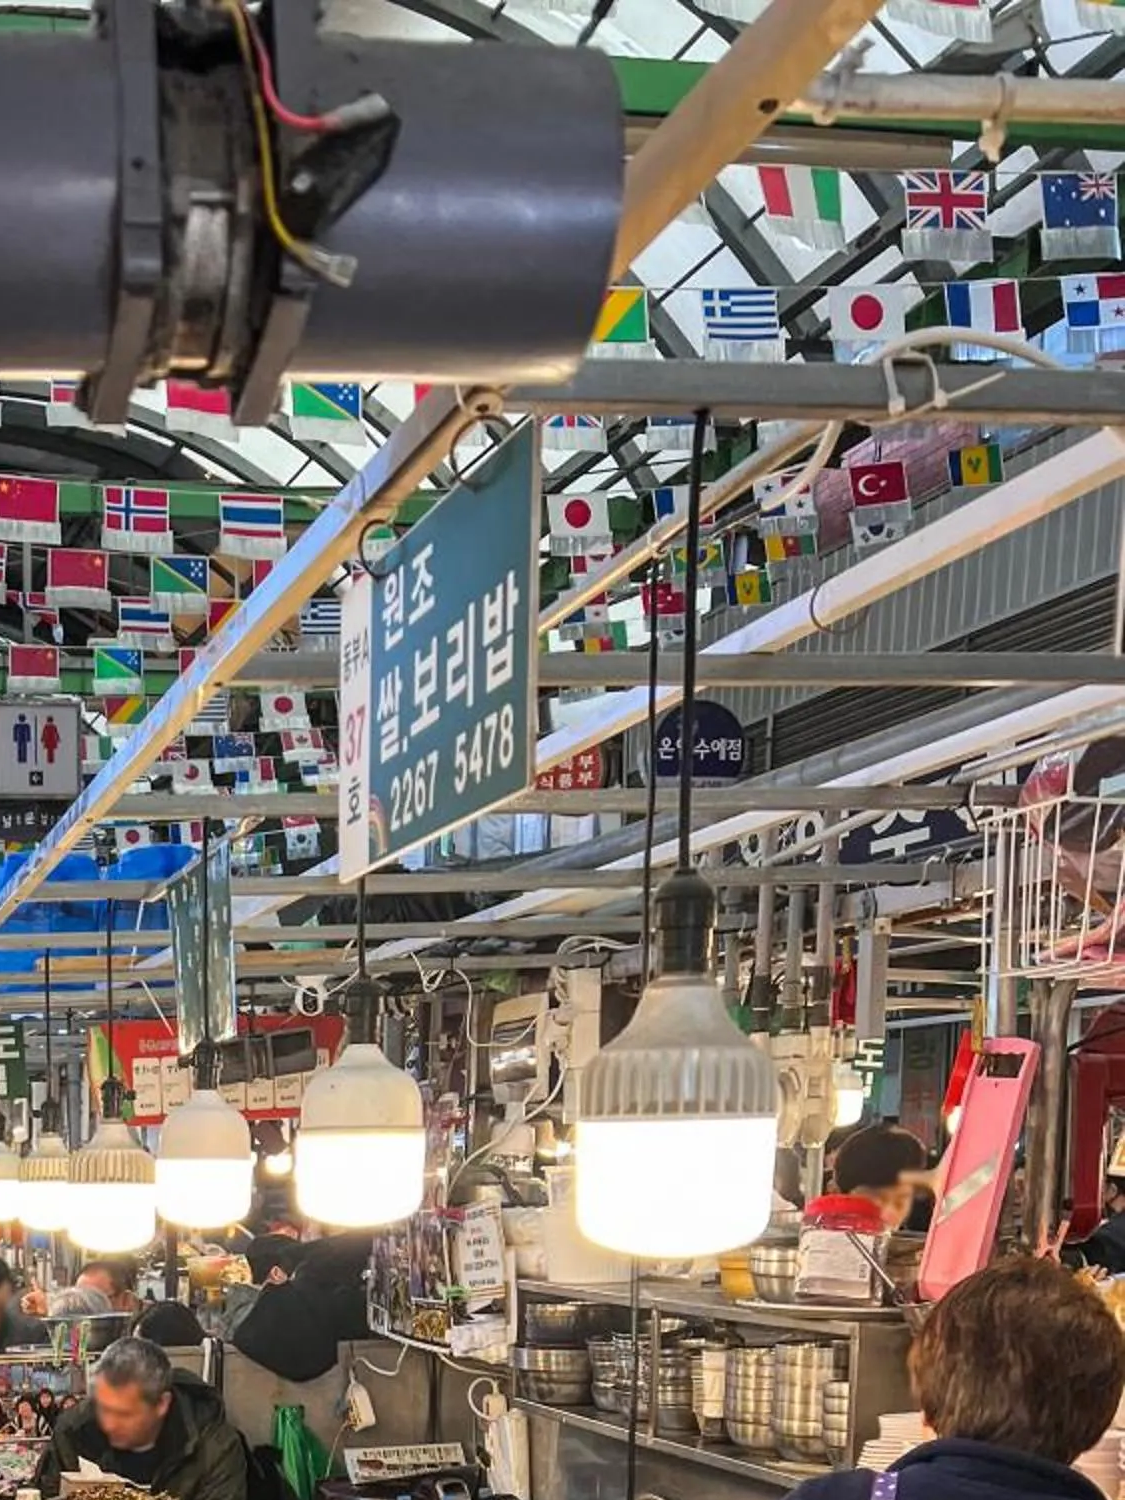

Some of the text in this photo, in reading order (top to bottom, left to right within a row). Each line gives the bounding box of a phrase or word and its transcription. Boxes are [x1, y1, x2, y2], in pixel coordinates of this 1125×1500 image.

[382, 542, 435, 651] 원조
[344, 704, 366, 766] 37
[390, 703, 515, 833] 2267 5478
